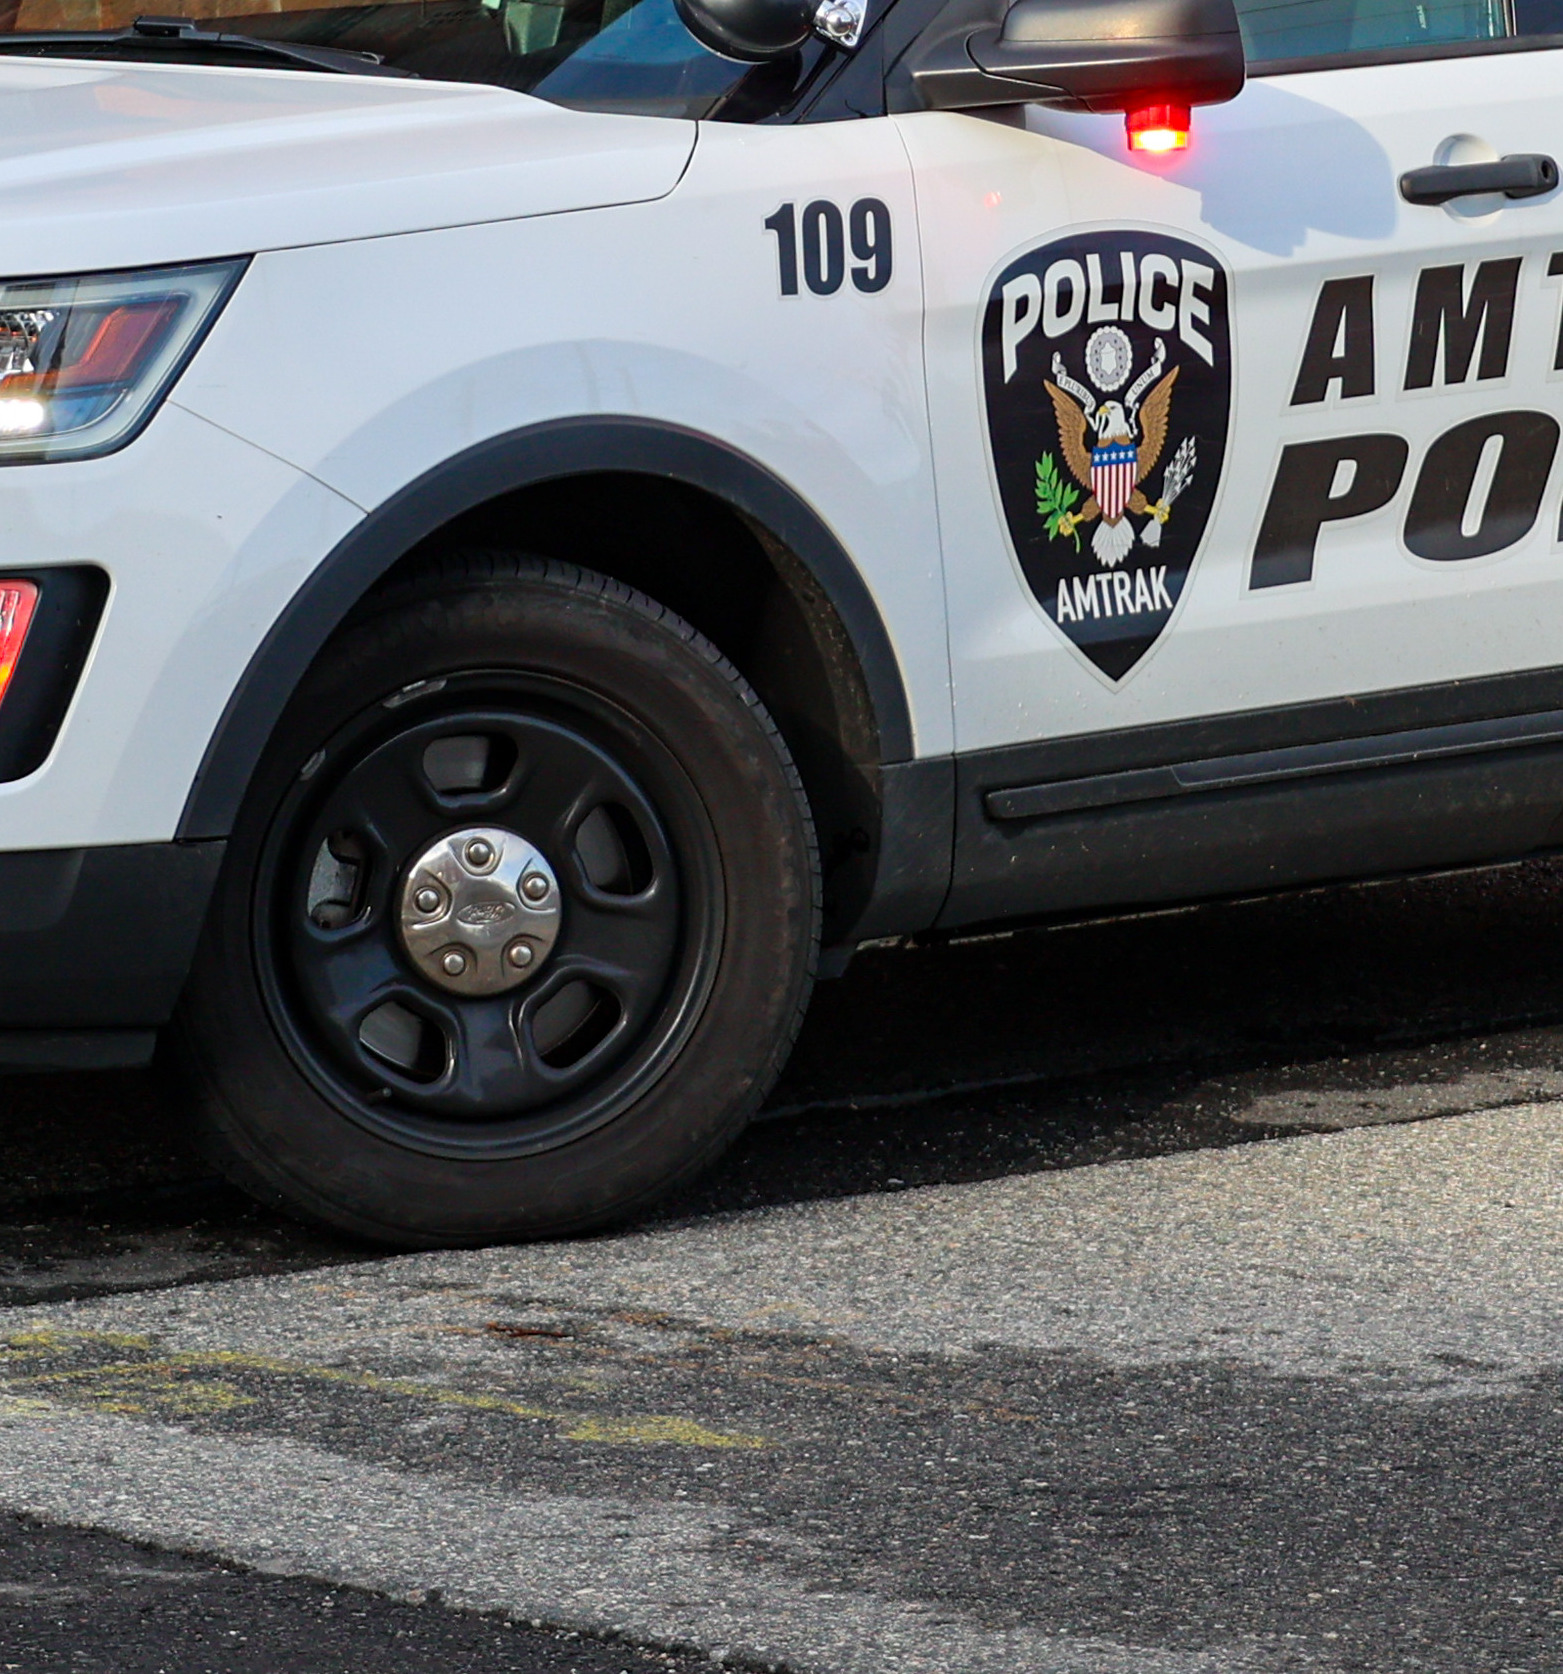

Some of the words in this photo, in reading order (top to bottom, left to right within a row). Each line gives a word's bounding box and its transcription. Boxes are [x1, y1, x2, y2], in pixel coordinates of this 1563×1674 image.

[764, 197, 893, 296] 109
[1002, 251, 1215, 385] POLICE
[1056, 565, 1173, 624] AMTRAK
